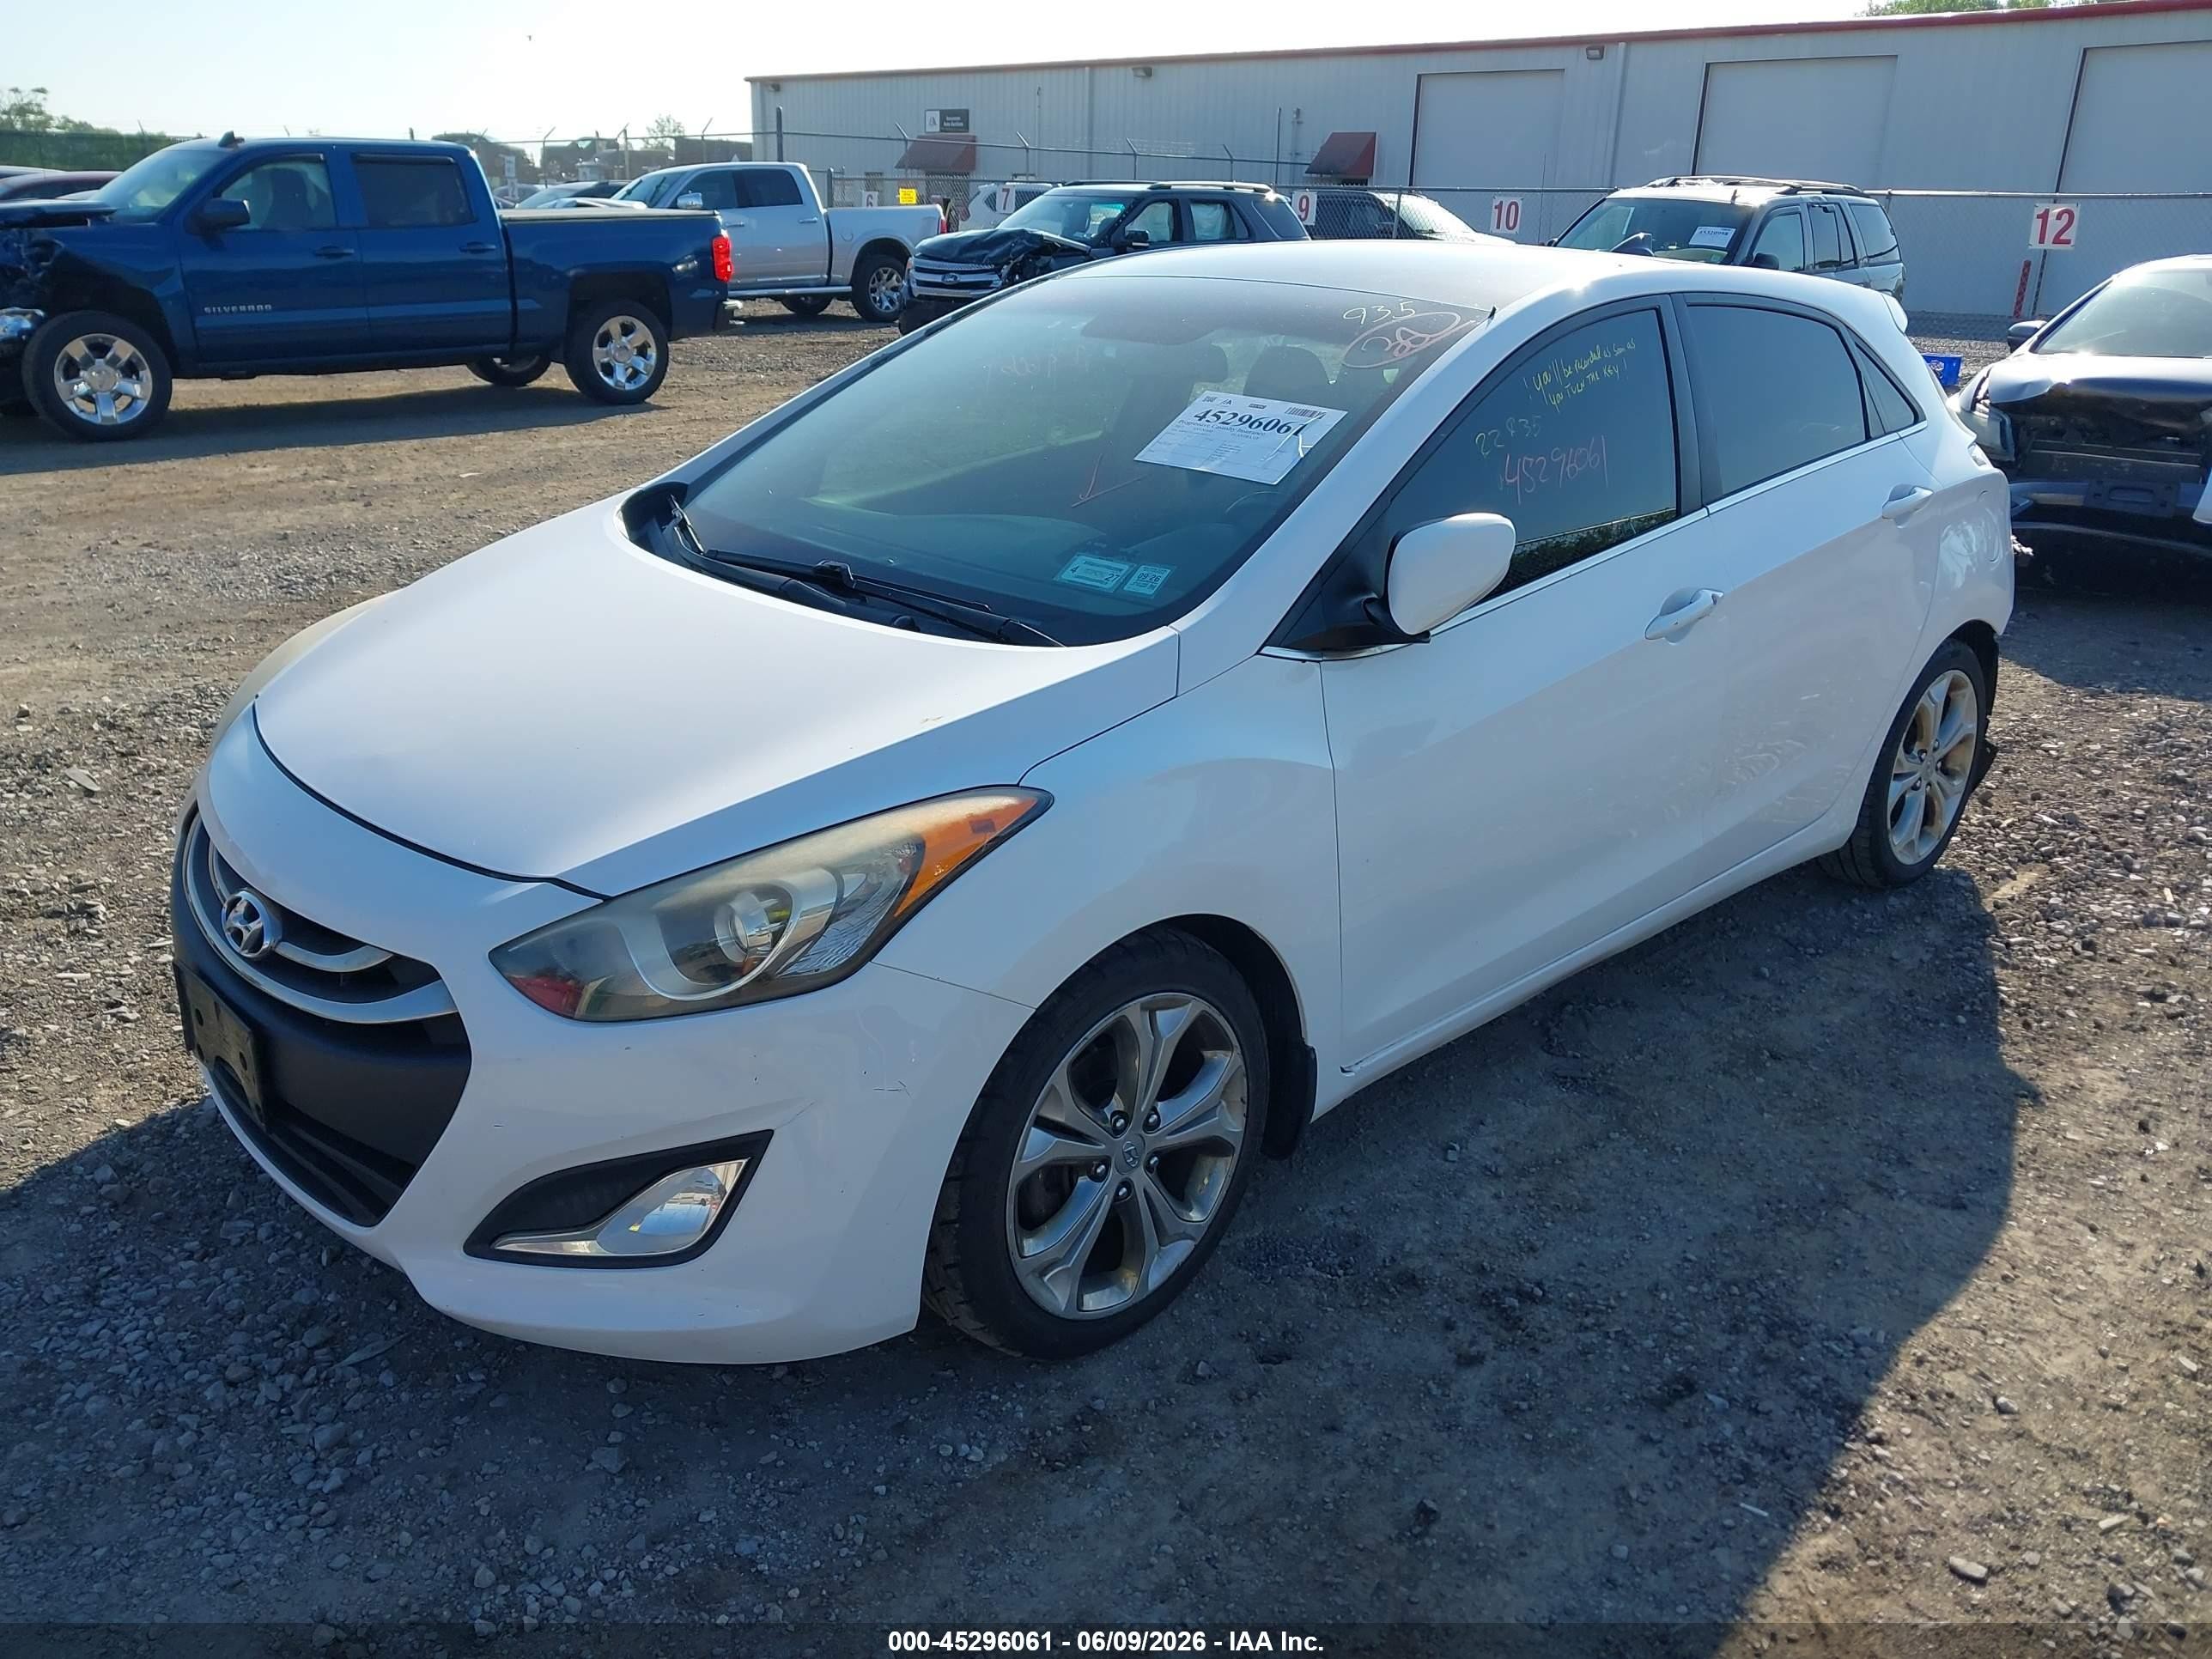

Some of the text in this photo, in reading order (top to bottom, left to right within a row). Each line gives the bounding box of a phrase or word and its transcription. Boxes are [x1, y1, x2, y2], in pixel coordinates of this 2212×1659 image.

[866, 194, 873, 207] 6
[1002, 188, 1011, 210] 7
[1298, 195, 1310, 222] 9
[1493, 200, 1520, 230] 10
[2036, 208, 2075, 245] 12
[1343, 301, 1416, 325] 935
[1193, 408, 1309, 437] 45296061
[1504, 434, 1609, 507] 45296061
[1104, 573, 1120, 582] 27
